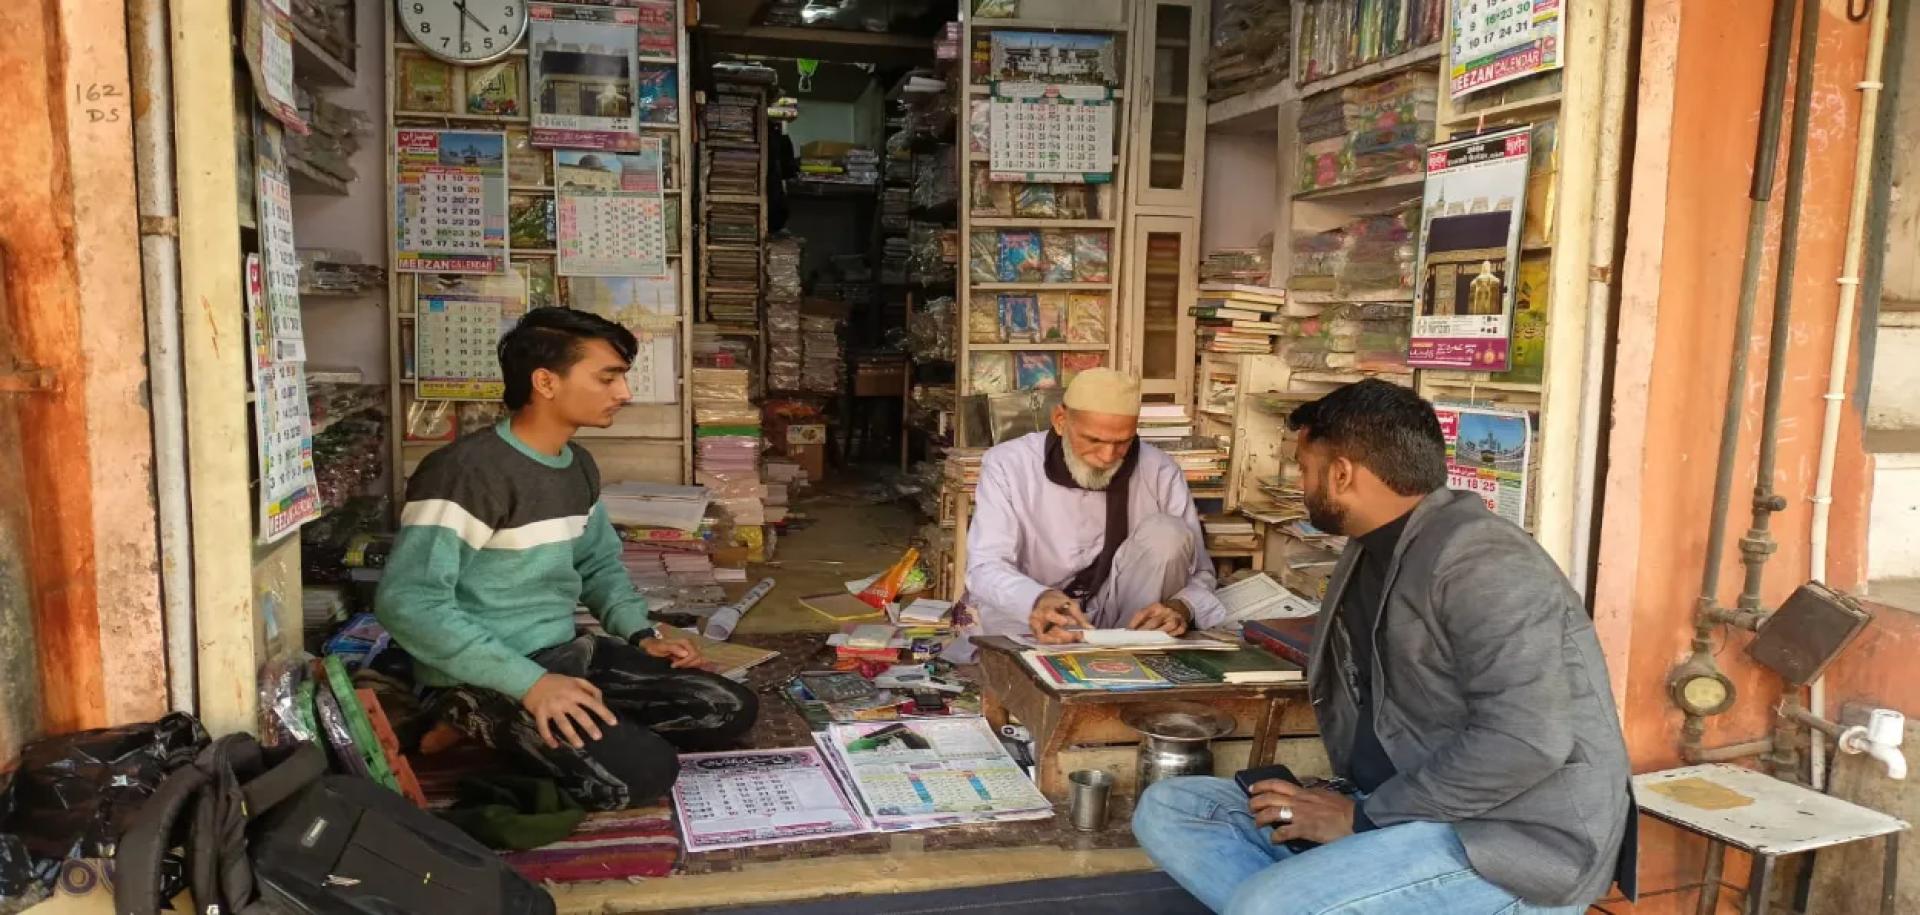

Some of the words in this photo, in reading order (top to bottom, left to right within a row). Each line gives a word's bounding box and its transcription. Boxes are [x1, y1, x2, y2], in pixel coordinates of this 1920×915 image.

[413, 3, 423, 14] 9
[504, 6, 514, 17] 3
[1471, 3, 1477, 14] 8
[1470, 22, 1476, 31] 9
[1516, 1, 1531, 14] 30
[420, 22, 430, 33] 8
[499, 25, 508, 36] 4
[440, 37, 450, 48] 7
[1455, 46, 1462, 55] 3
[1469, 37, 1480, 49] 10
[1484, 32, 1494, 43] 17
[1498, 26, 1511, 38] 24
[1516, 20, 1527, 32] 31
[462, 41, 472, 53] 6
[483, 38, 493, 49] 5
[76, 83, 123, 105] 162
[437, 239, 447, 247] 17
[399, 259, 449, 270] MEEZAN
[1452, 477, 1461, 486] 11
[1467, 479, 1479, 489] 18
[1482, 481, 1495, 492] 25
